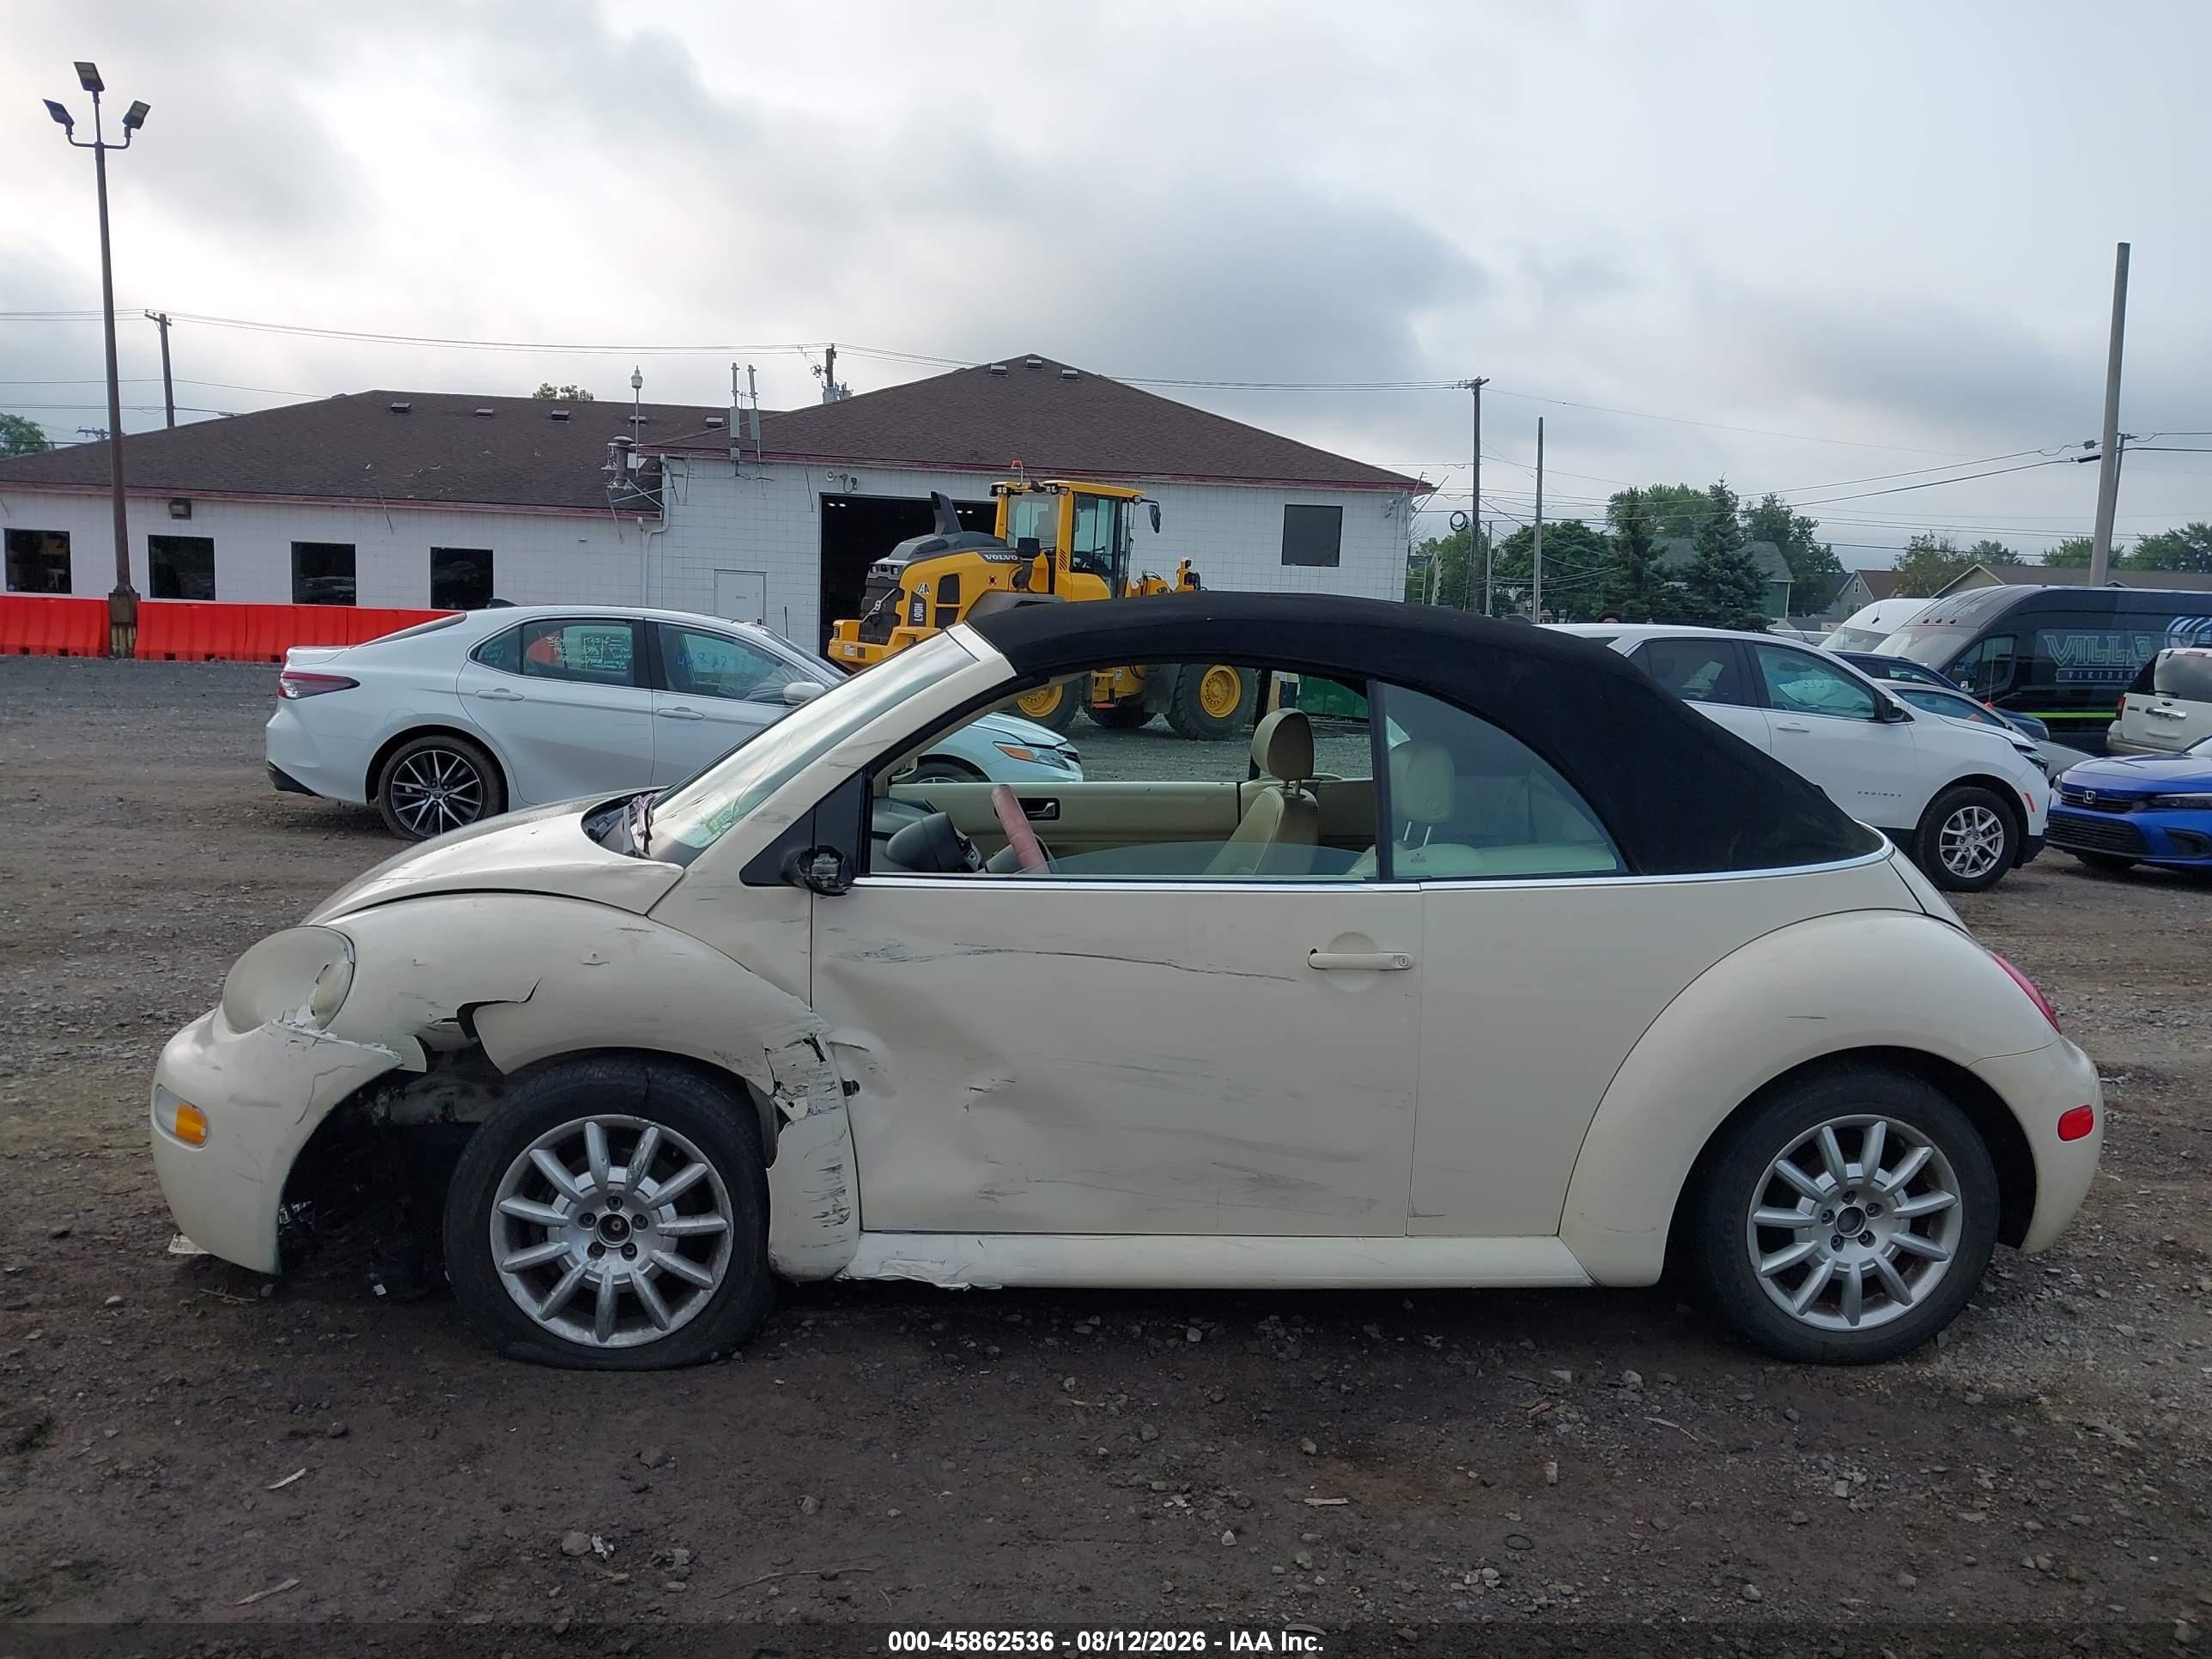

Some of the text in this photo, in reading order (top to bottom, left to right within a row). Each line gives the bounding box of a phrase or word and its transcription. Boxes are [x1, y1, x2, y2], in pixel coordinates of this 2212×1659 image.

[914, 603, 924, 622] L90H
[2043, 635, 2153, 666] VILLA
[2068, 671, 2133, 680] VIKINGS
